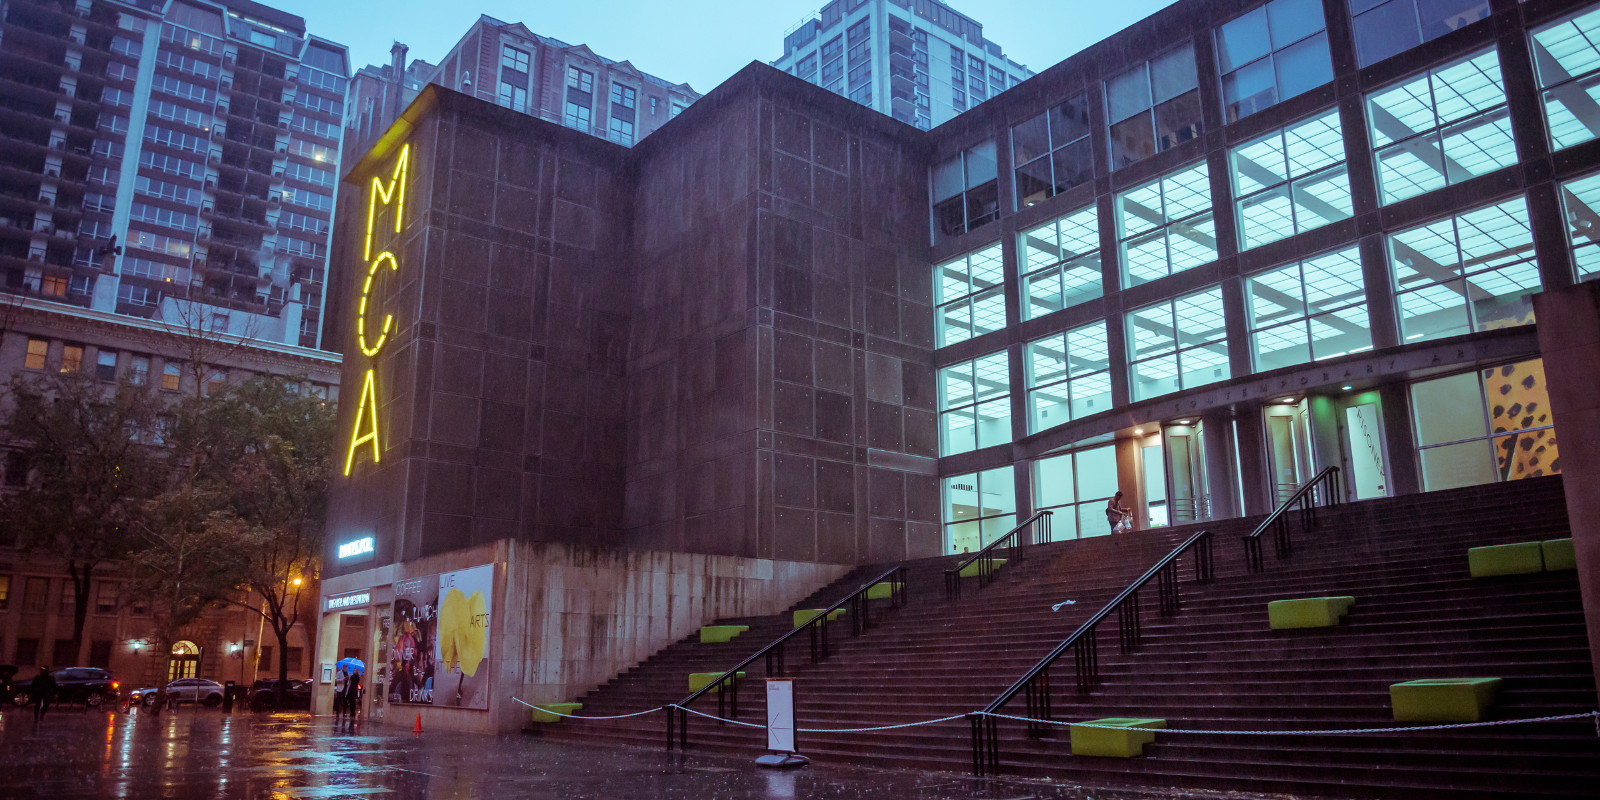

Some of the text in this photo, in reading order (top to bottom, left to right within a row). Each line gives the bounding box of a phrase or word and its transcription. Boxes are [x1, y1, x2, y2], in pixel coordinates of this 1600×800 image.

[344, 143, 409, 477] MCA
[1356, 407, 1385, 481] RISONER
[395, 580, 421, 596] COFFEE
[440, 574, 455, 588] LIVE
[413, 604, 437, 621] LUNCH
[470, 613, 489, 628] ARTS
[409, 688, 433, 703] DRINKS
